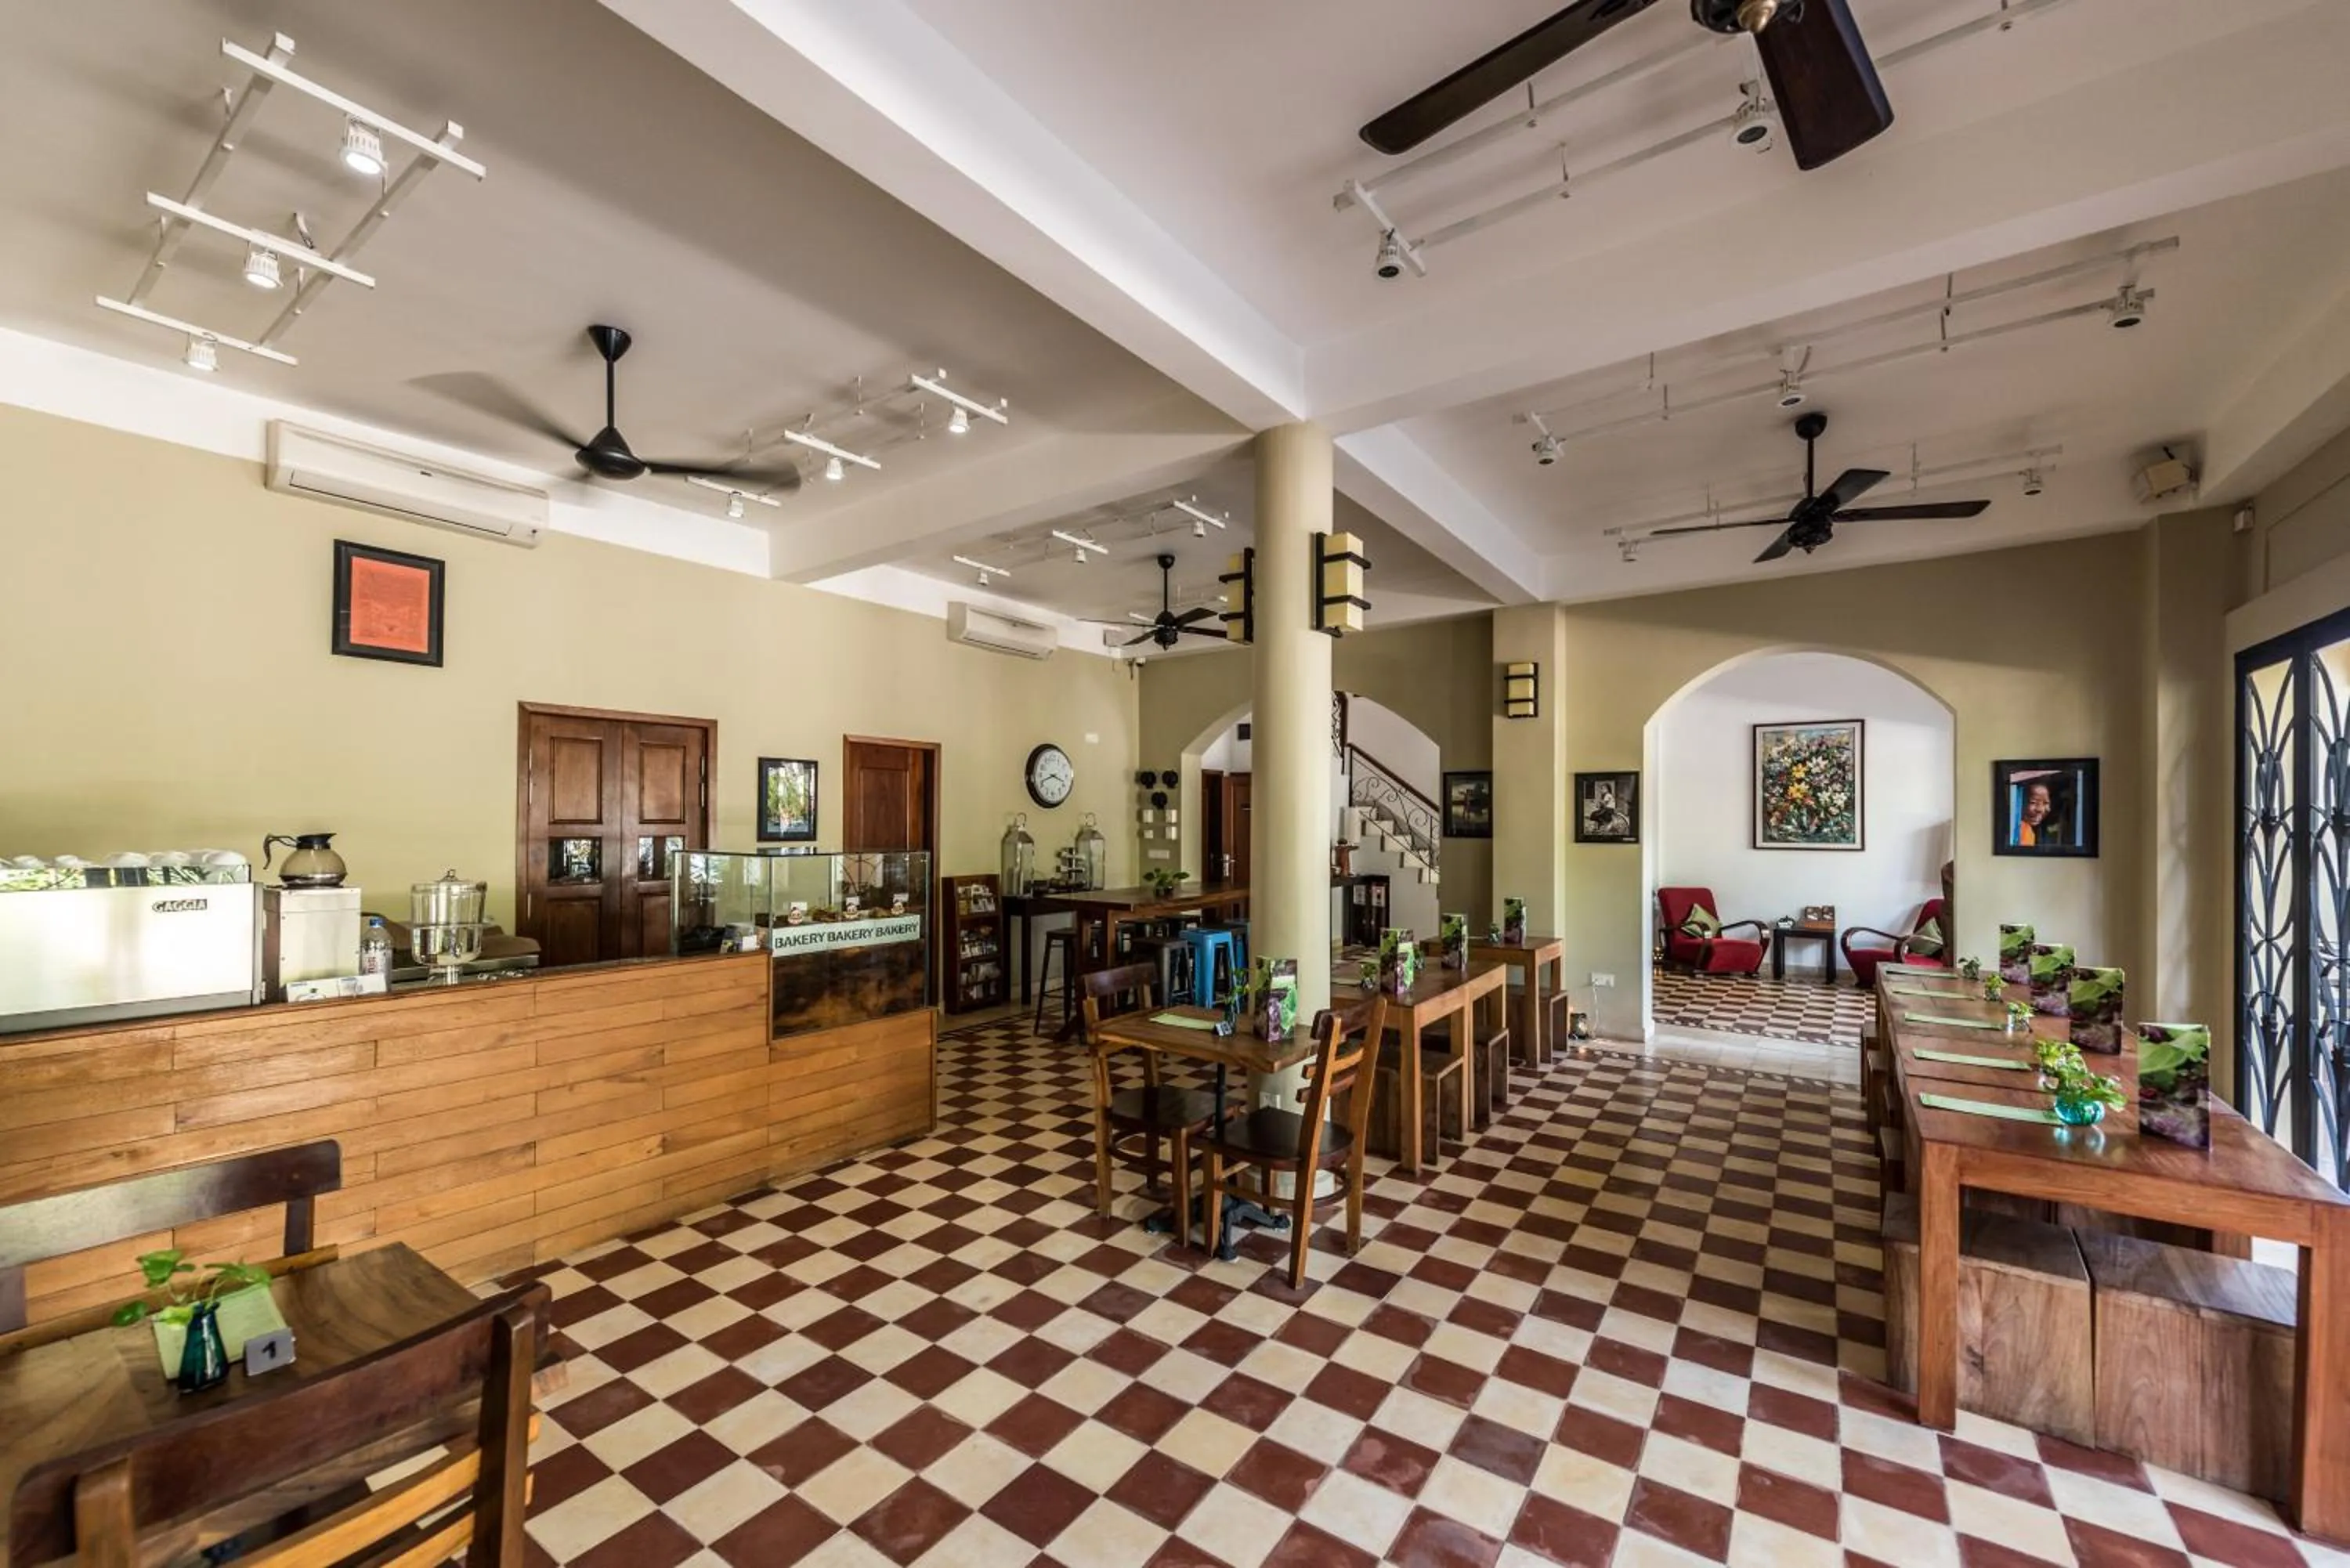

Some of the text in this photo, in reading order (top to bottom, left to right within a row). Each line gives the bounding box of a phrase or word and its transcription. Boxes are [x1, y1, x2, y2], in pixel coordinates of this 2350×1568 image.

[151, 899, 207, 912] GAGGIA
[775, 923, 919, 948] BAKERY BAKERY BAKERY
[262, 1340, 276, 1360] 1
